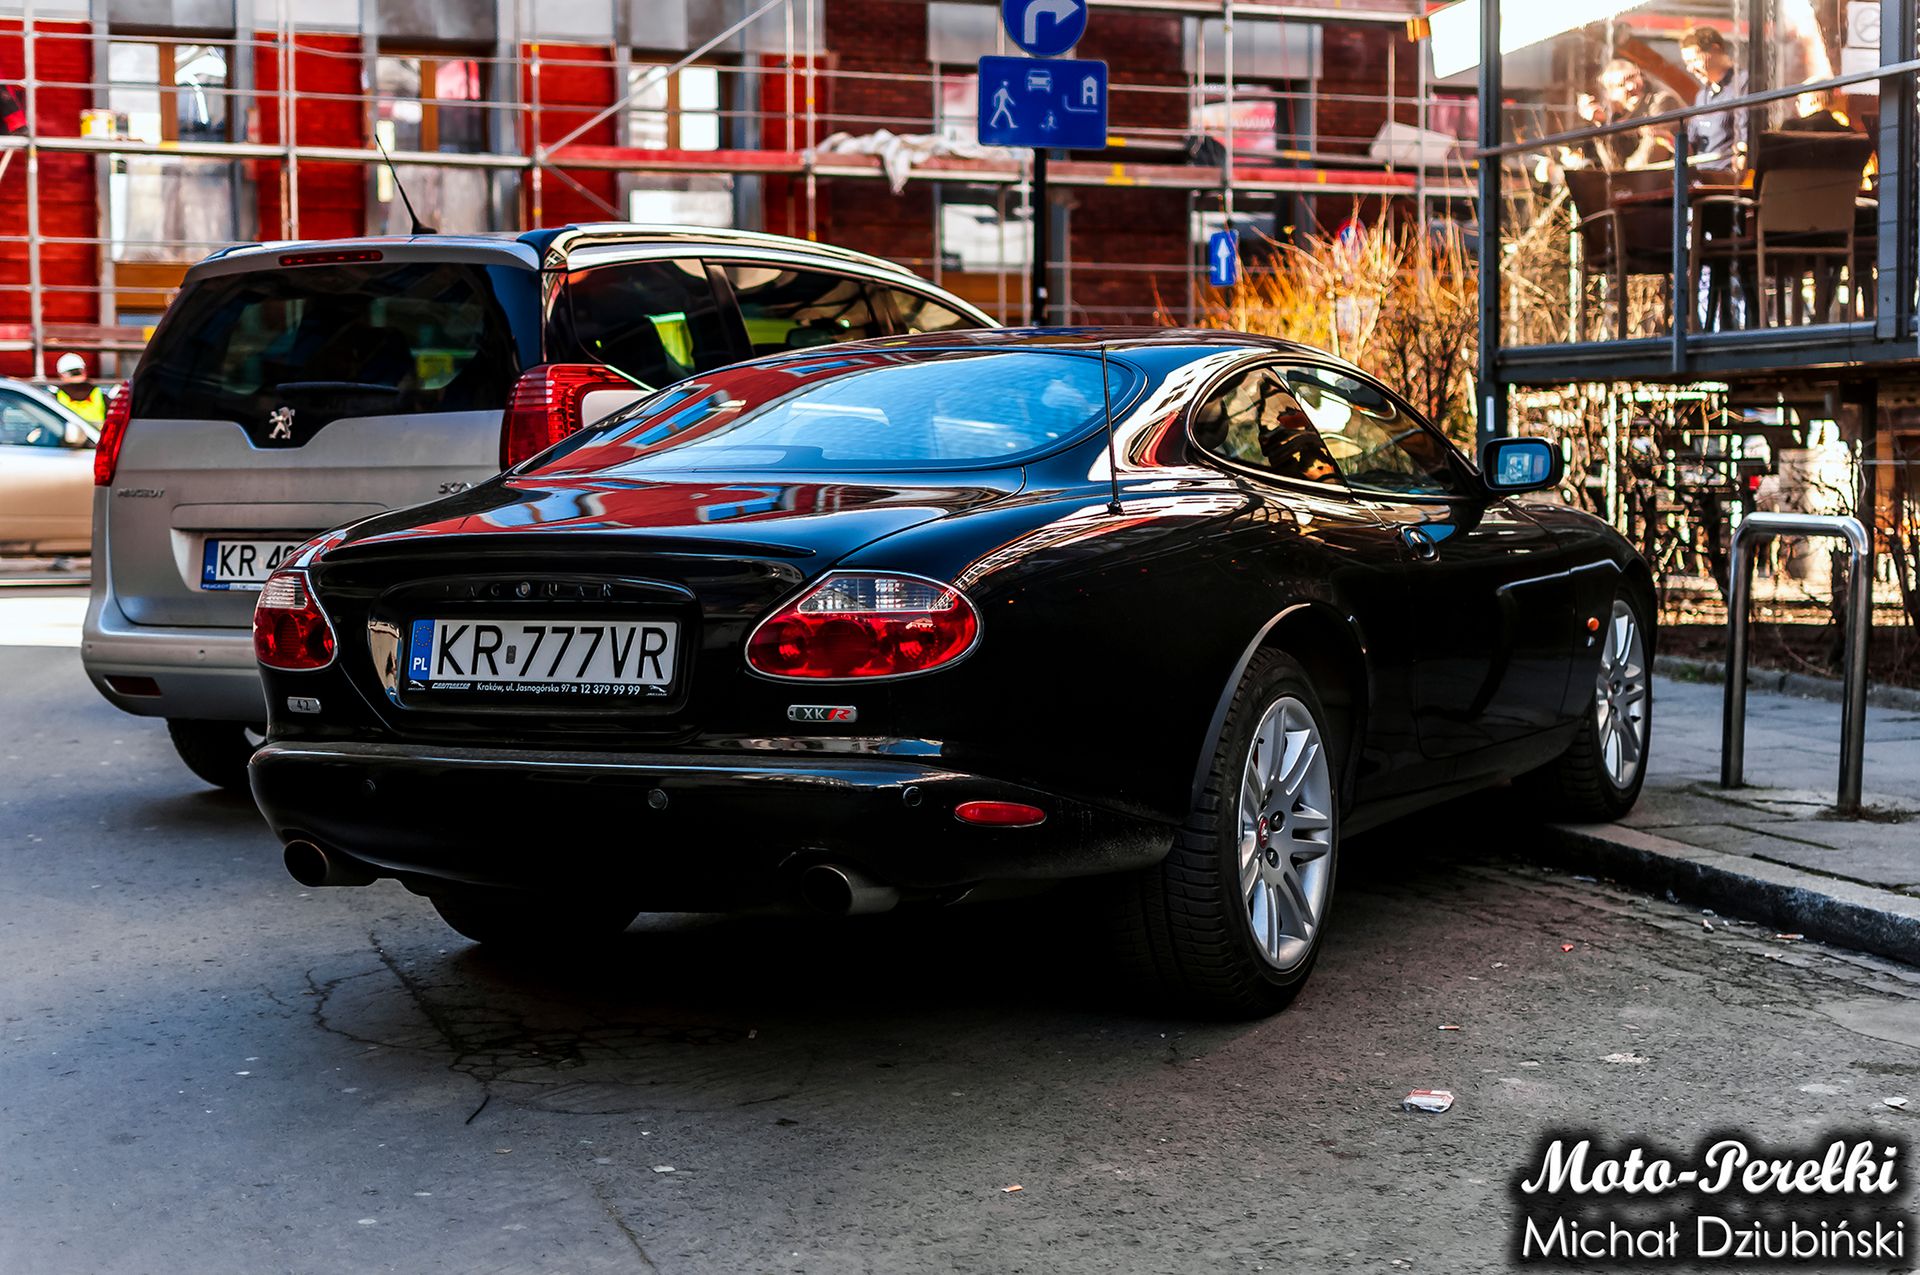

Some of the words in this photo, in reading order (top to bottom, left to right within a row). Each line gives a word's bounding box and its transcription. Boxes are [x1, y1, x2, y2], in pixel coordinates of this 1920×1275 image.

[220, 544, 257, 577] KR
[206, 565, 215, 574] PL
[437, 624, 503, 676] KR
[518, 626, 668, 680] 777VR
[413, 657, 428, 671] PL
[477, 682, 504, 692] Kraków,
[506, 684, 514, 692] ul.
[561, 683, 571, 692] 97
[581, 684, 591, 694] 12
[593, 684, 611, 695] 379
[612, 684, 626, 695] 99
[627, 685, 641, 696] 99
